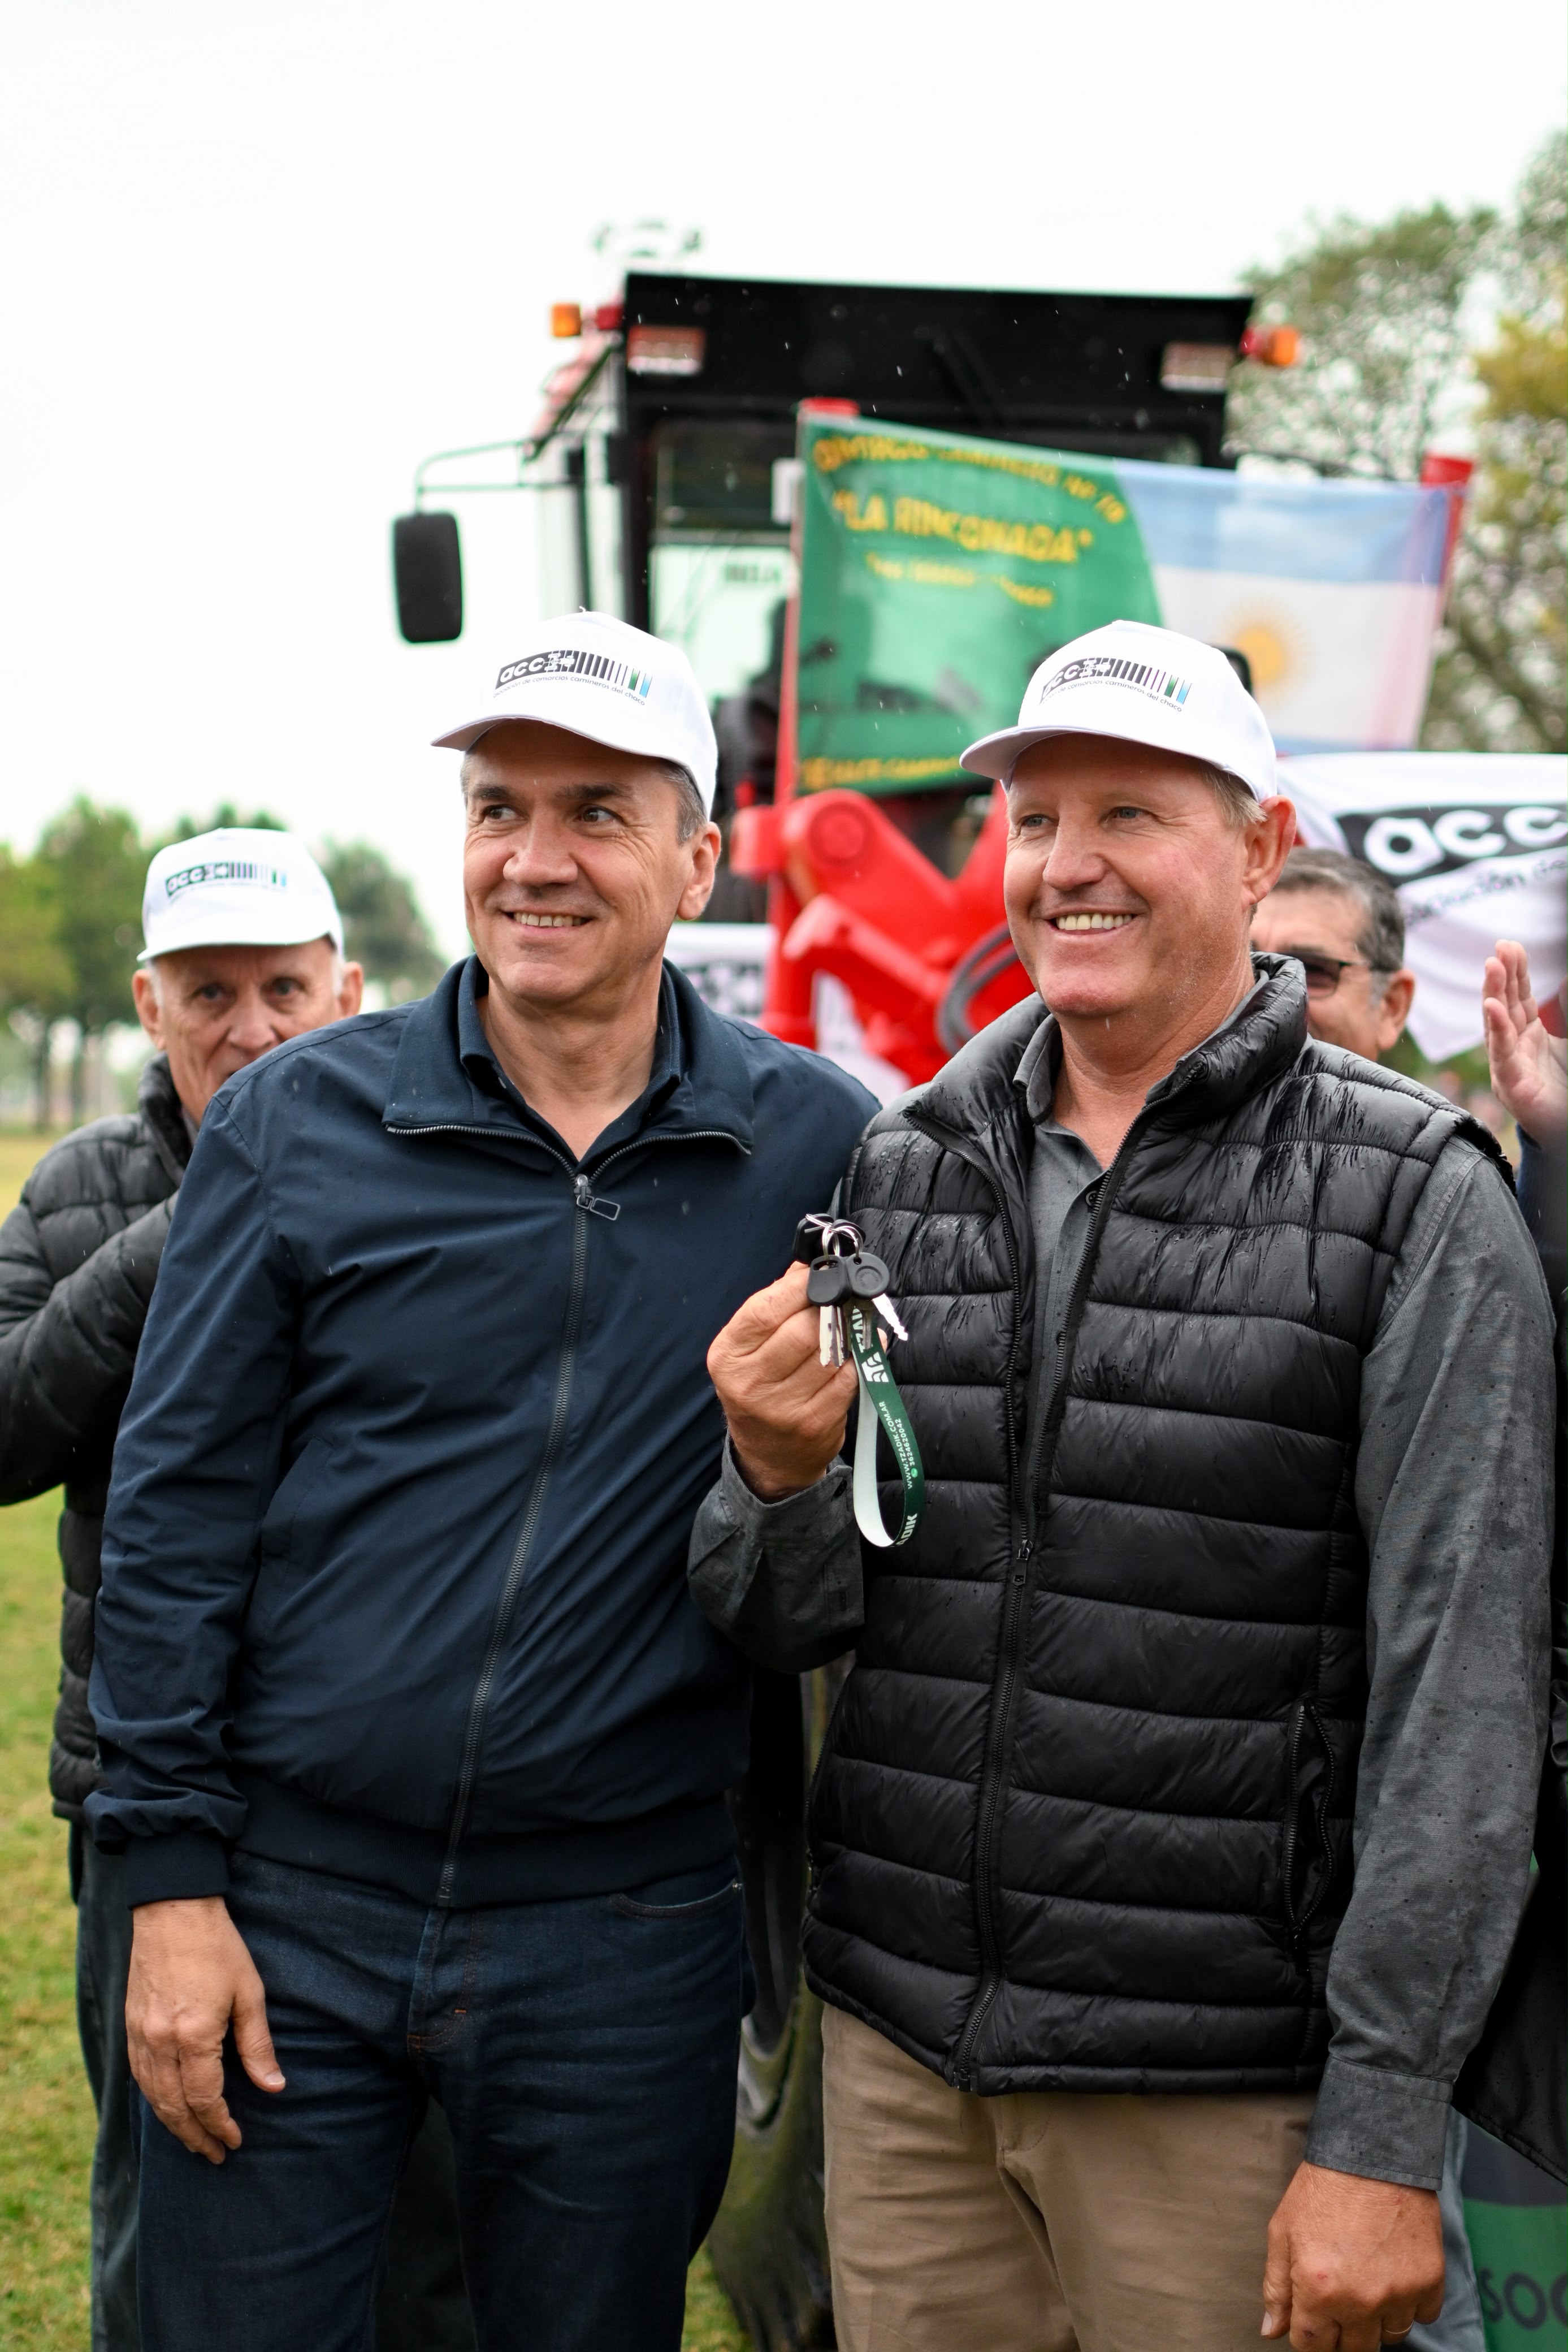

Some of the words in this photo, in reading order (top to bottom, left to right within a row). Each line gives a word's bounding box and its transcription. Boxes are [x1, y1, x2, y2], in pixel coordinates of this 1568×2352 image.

[570, 676, 609, 689] camineros
[612, 686, 623, 694] del
[625, 691, 645, 706] chaco
[1068, 680, 1103, 690] consorcios
[1105, 680, 1145, 694] camineros
[1146, 692, 1159, 702] del
[1160, 698, 1182, 712] chaco
[1363, 806, 1568, 876] acc
[879, 1400, 913, 1490] WWW.TZADIK.COM.AR
[895, 1419, 915, 1467] 3624620042
